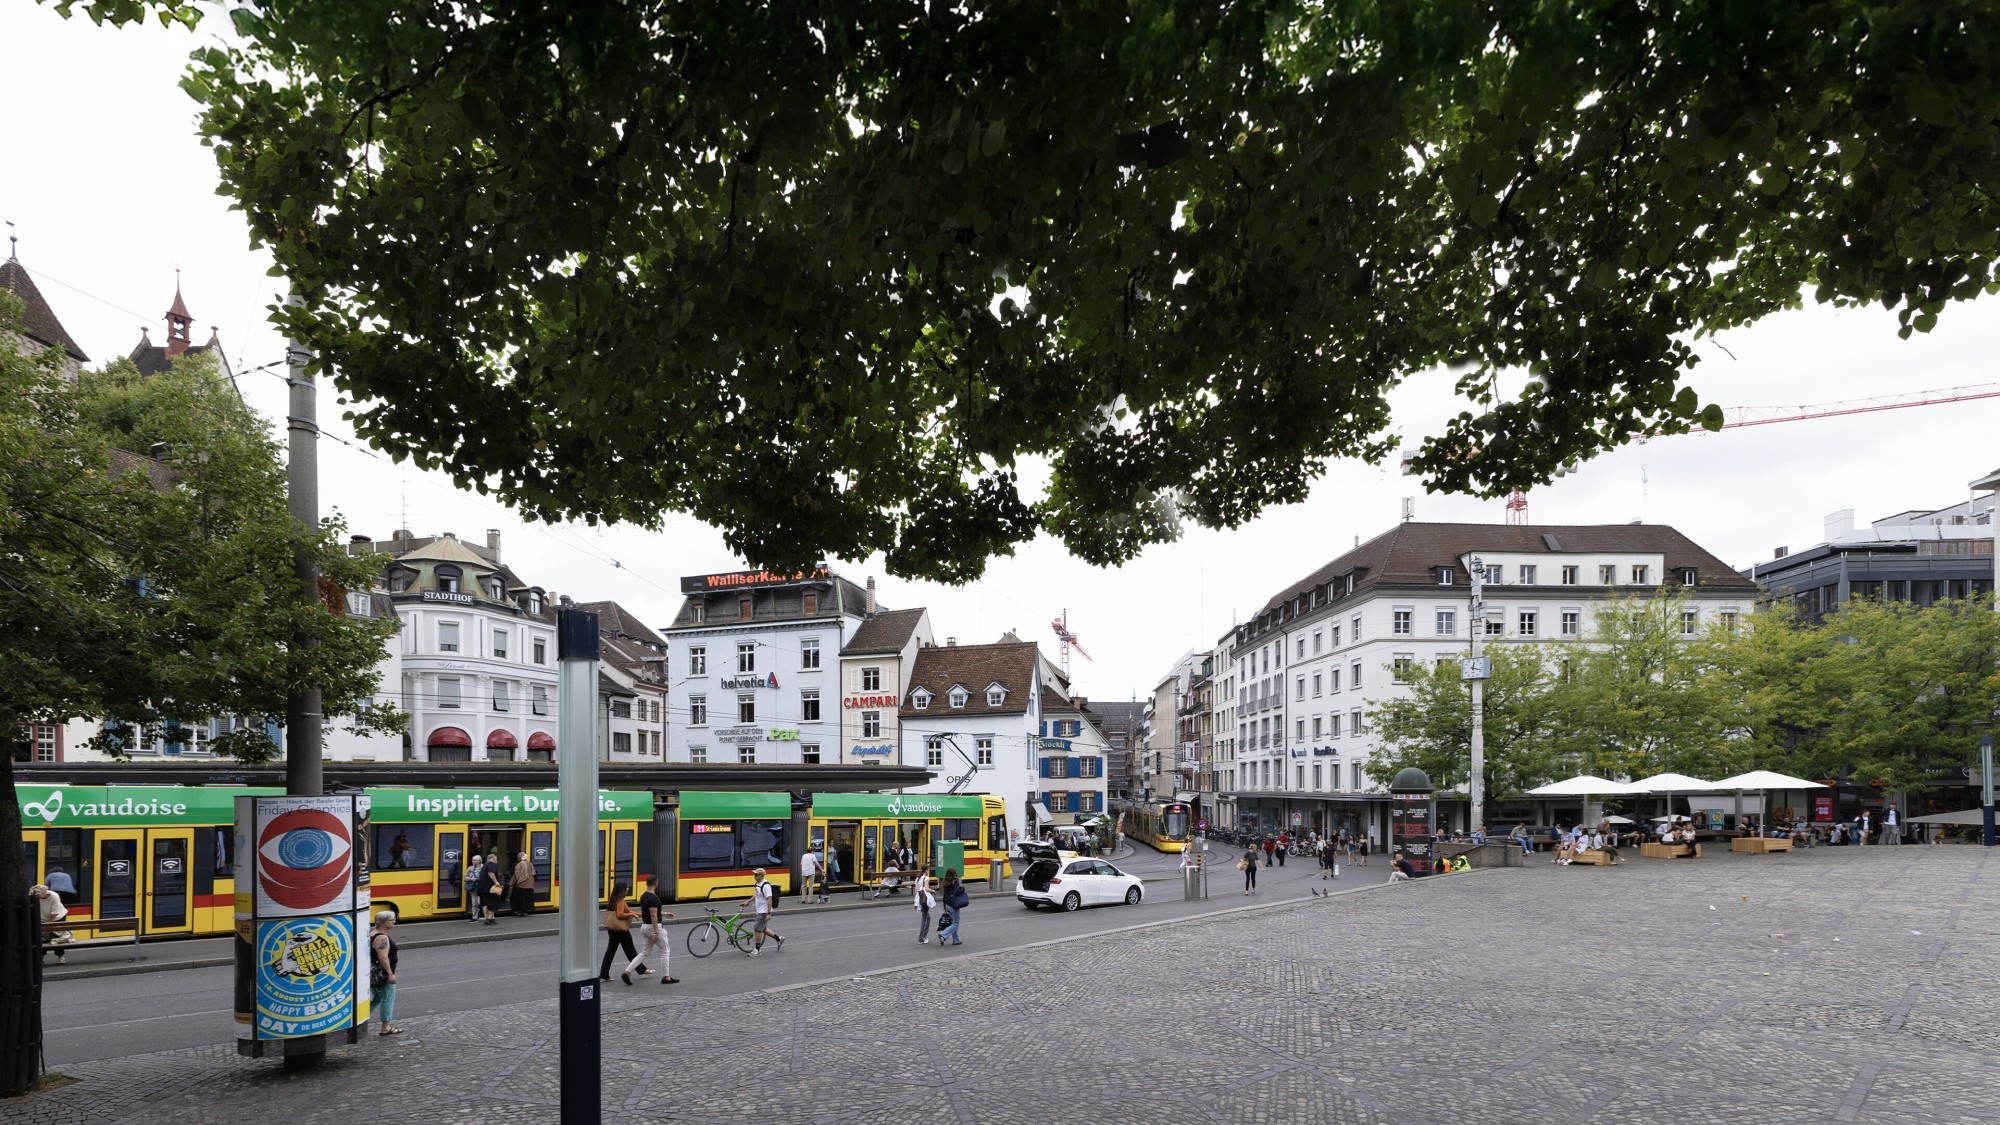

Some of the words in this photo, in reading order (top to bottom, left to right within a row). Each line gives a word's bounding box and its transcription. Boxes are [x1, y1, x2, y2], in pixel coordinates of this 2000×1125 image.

[707, 571, 803, 587] WalliserKae
[424, 591, 473, 602] STADTHOF
[721, 676, 766, 690] helvetia
[844, 695, 897, 709] CAMPARI
[67, 798, 186, 816] vaudoise
[258, 805, 293, 817] Friday
[298, 804, 351, 816] Graphics
[408, 794, 518, 817] Inspiriert.
[524, 796, 560, 812] Dur
[902, 802, 942, 813] vaudoise
[299, 950, 340, 974] STREET
[273, 990, 304, 1002] AUGUST
[268, 1002, 301, 1016] HAPPY
[260, 1016, 299, 1033] DAY
